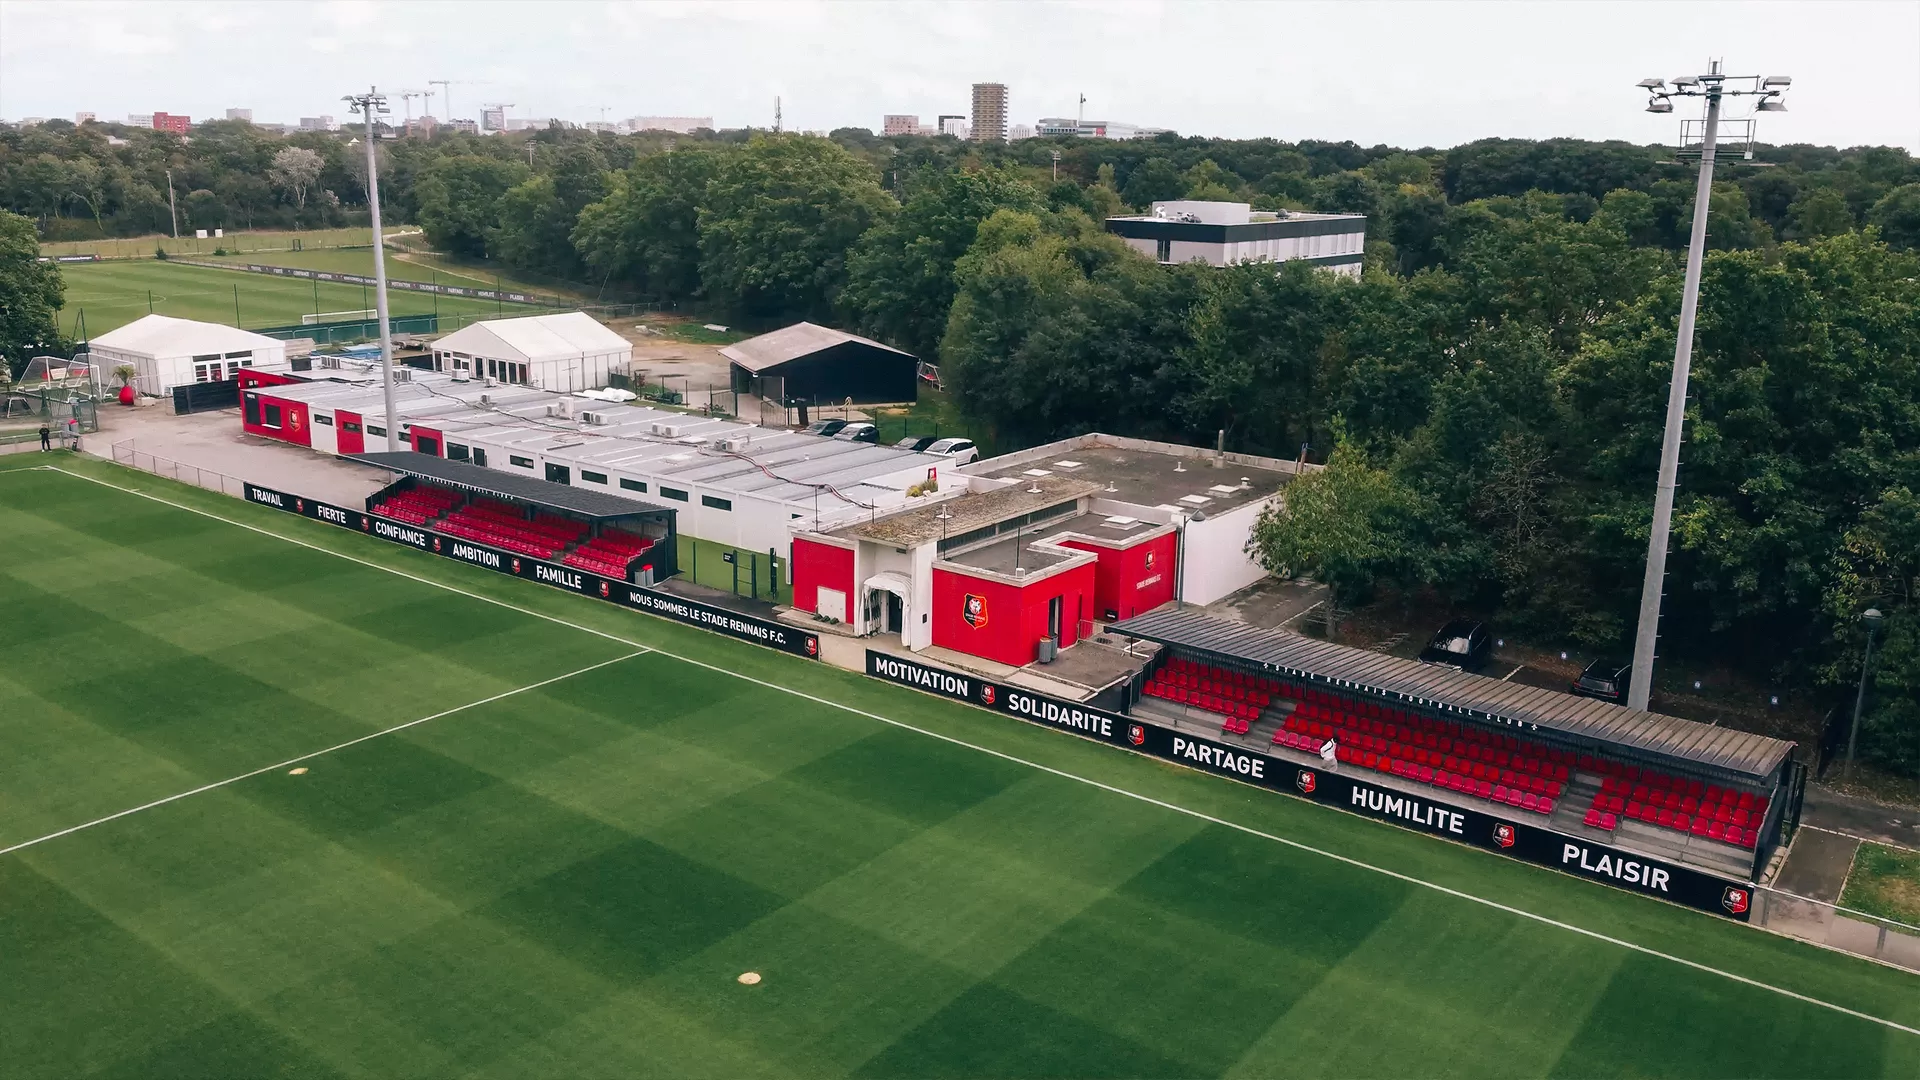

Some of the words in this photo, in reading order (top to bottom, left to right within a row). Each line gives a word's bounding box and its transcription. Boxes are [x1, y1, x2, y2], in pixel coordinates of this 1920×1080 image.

[252, 488, 284, 507] TRAVAIL
[317, 505, 347, 524] FIERTE
[375, 521, 426, 547] CONFIANCE
[453, 543, 500, 568] AMBITION
[536, 565, 582, 589] FAMILLE
[629, 591, 652, 607] NOUS
[653, 598, 689, 617] SOMMES
[689, 608, 700, 621] LE
[701, 611, 729, 629] STADE
[729, 618, 768, 640] RENNAIS
[769, 629, 787, 645] F.C.
[875, 656, 968, 697] MOTIVATION
[1275, 664, 1315, 680] STADE
[1326, 675, 1387, 696] RENNAIS
[1399, 693, 1473, 716] FOOTBALL
[1486, 713, 1523, 728] CLUB
[1008, 693, 1113, 737] SOLIDARITE
[1173, 737, 1264, 779] PARTAGE
[1351, 785, 1465, 834] HUMILITE
[1562, 843, 1670, 892] PLAISIR
